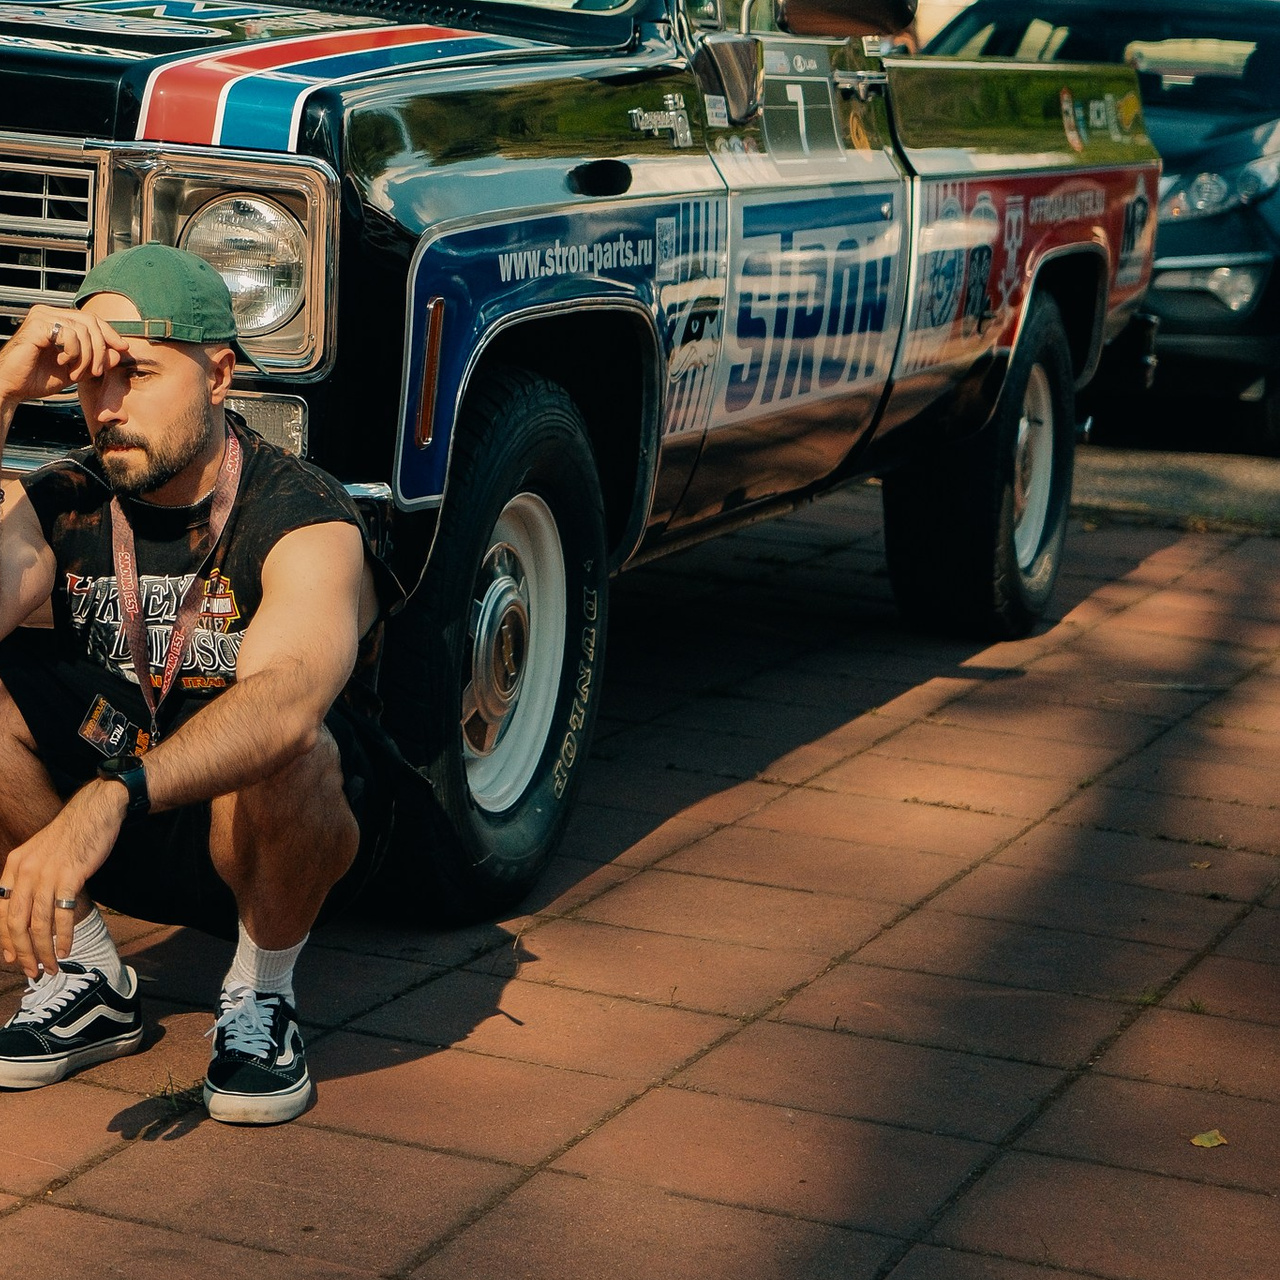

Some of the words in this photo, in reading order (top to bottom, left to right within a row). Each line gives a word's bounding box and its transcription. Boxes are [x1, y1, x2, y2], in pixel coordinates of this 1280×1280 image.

[498, 232, 653, 282] www.stron-parts.ru
[724, 193, 894, 414] STRON
[66, 573, 198, 625] HAREY
[123, 591, 139, 613] FEST
[170, 631, 185, 656] FEST
[551, 585, 598, 800] DUNLOP
[109, 723, 125, 746] PRESS
